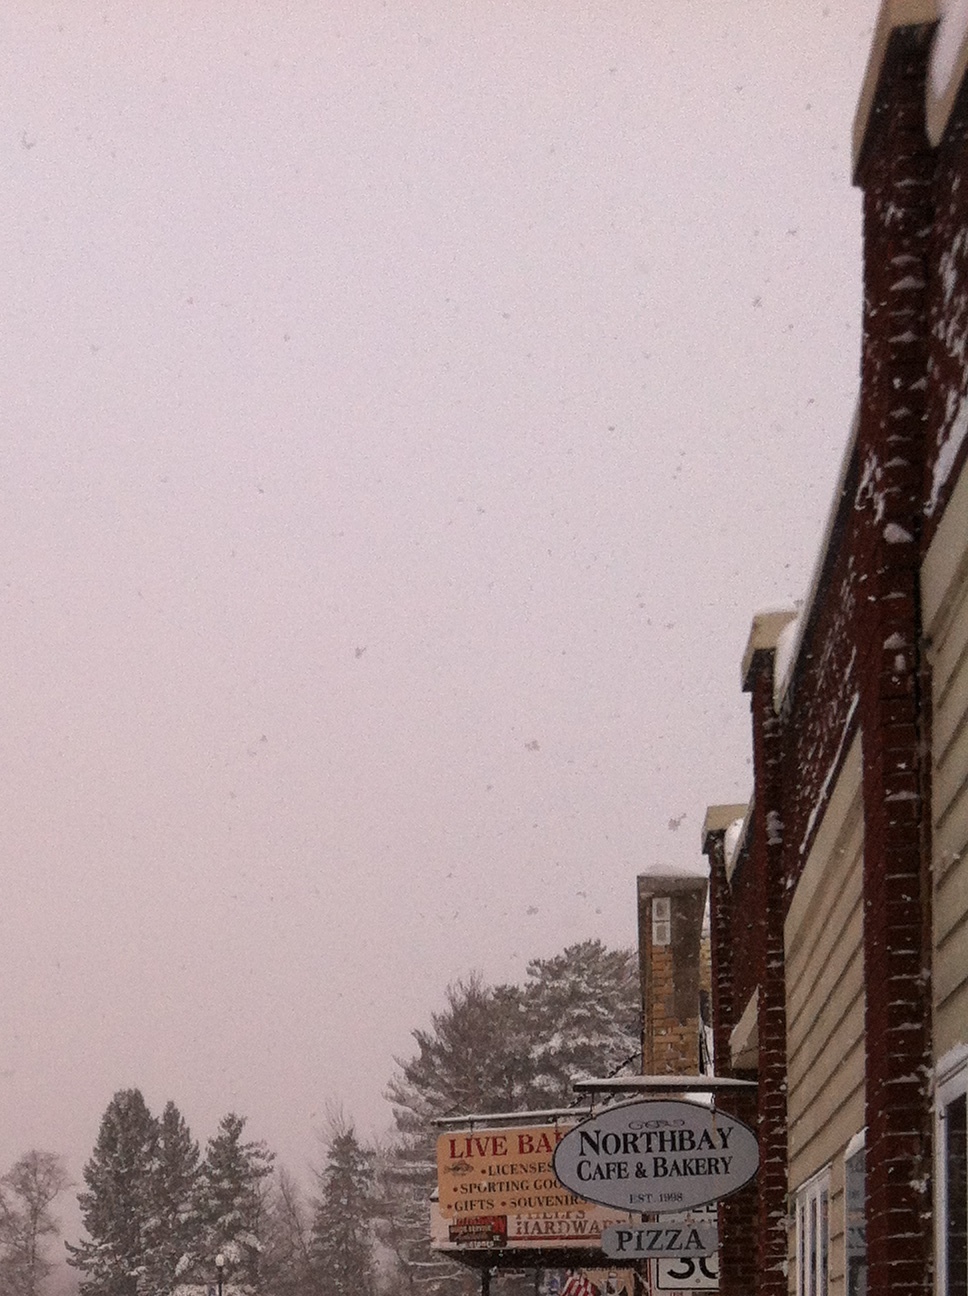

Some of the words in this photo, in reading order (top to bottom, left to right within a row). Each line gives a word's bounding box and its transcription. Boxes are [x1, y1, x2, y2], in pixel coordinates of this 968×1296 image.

[449, 1135, 508, 1159] LIVE
[578, 1126, 735, 1157] NORTHBAY
[576, 1160, 630, 1182] CAFE
[635, 1161, 648, 1178] &
[652, 1156, 734, 1179] BAKERY
[459, 1180, 530, 1195] SPORTING
[454, 1199, 495, 1212] GIFTS
[615, 1228, 707, 1251] PIZZA
